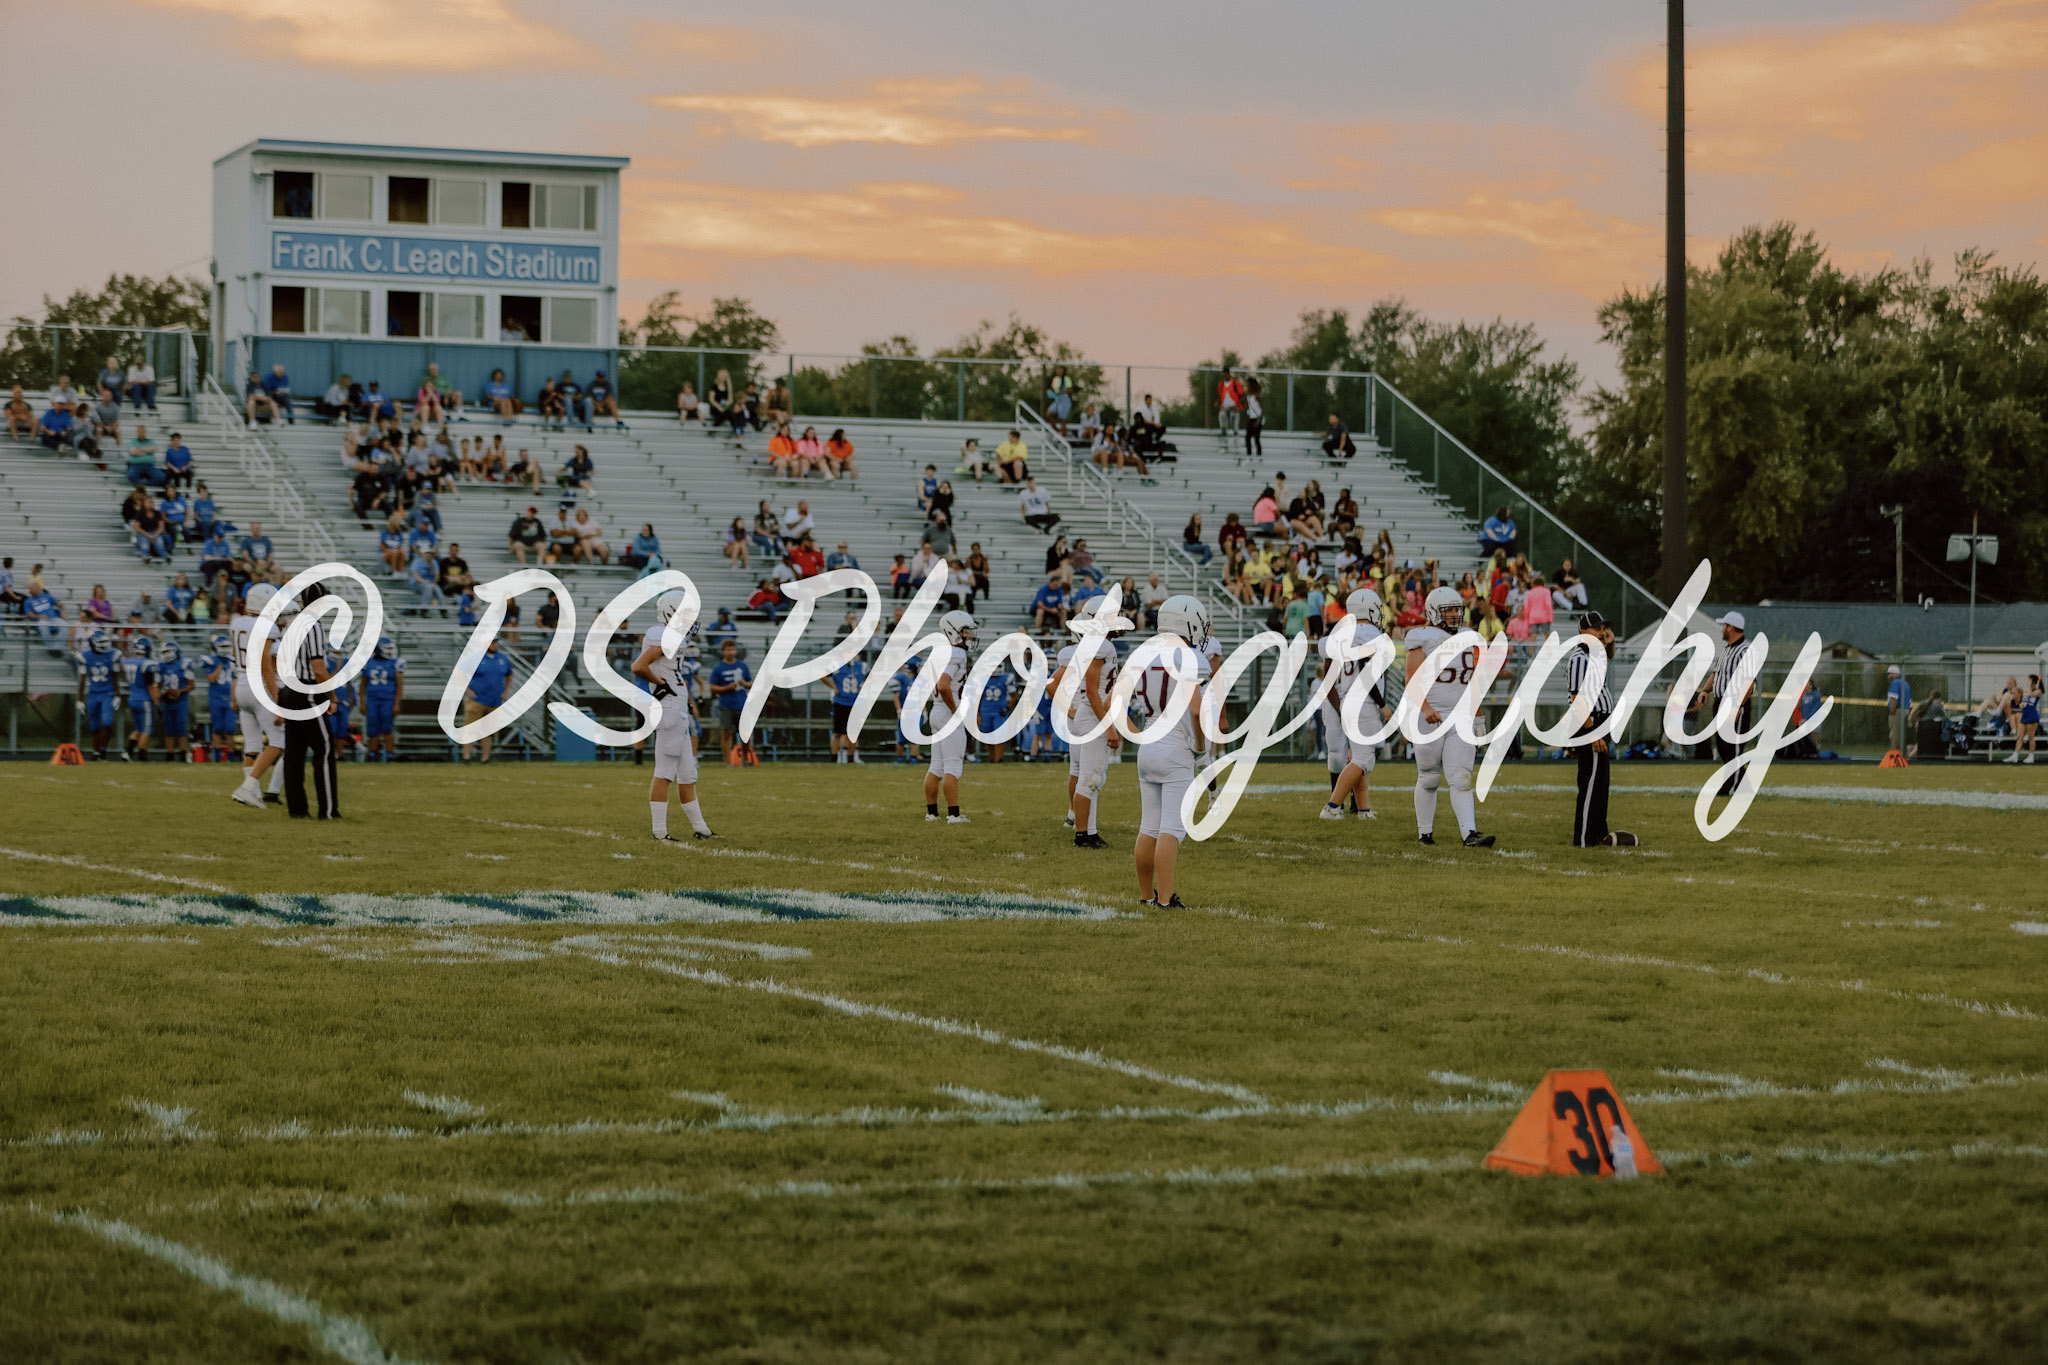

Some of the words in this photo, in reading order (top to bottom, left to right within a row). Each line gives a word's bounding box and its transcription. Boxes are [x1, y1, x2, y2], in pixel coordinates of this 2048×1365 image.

[273, 234, 354, 272] Frank
[360, 237, 389, 273] C.
[393, 239, 478, 276] Leach
[485, 242, 598, 282] Stadium
[1554, 1087, 1628, 1176] 30
